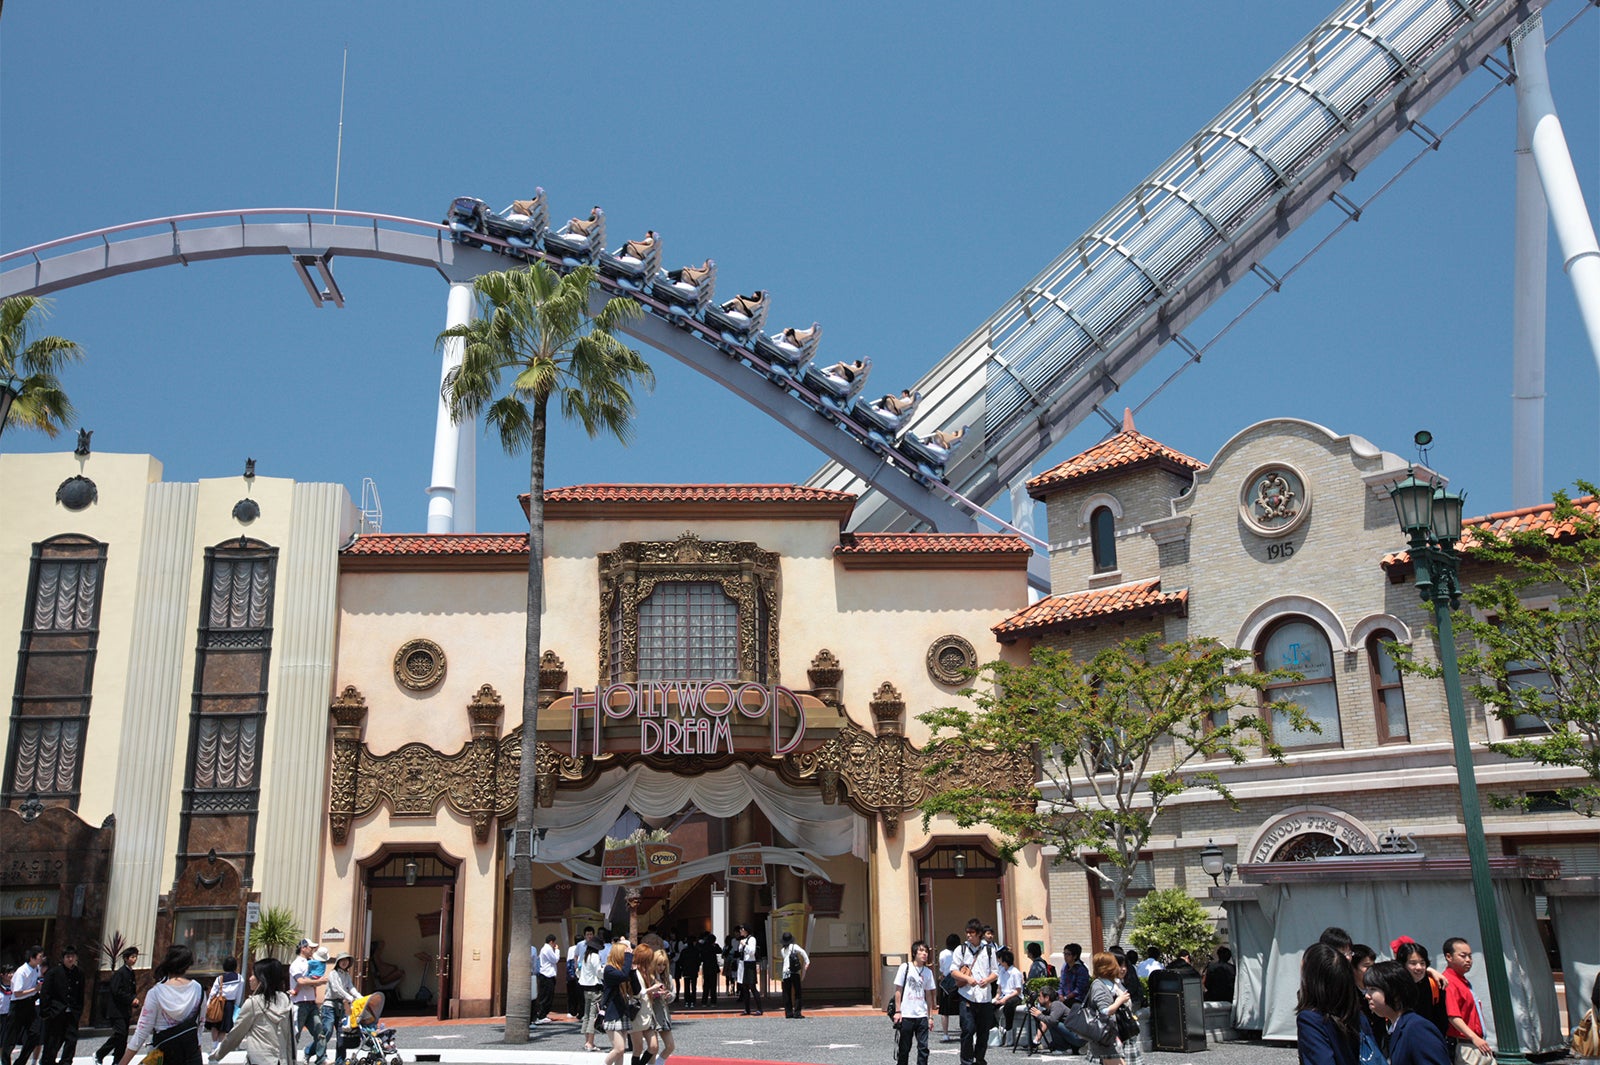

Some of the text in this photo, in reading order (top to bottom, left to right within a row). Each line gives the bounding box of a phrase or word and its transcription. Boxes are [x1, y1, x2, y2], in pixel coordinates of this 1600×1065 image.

[1266, 541, 1295, 560] 1915
[571, 680, 807, 758] HOLLYWOOD
[641, 716, 735, 755] DREAM
[1307, 816, 1338, 833] FIRE
[652, 854, 676, 864] EXPRESS
